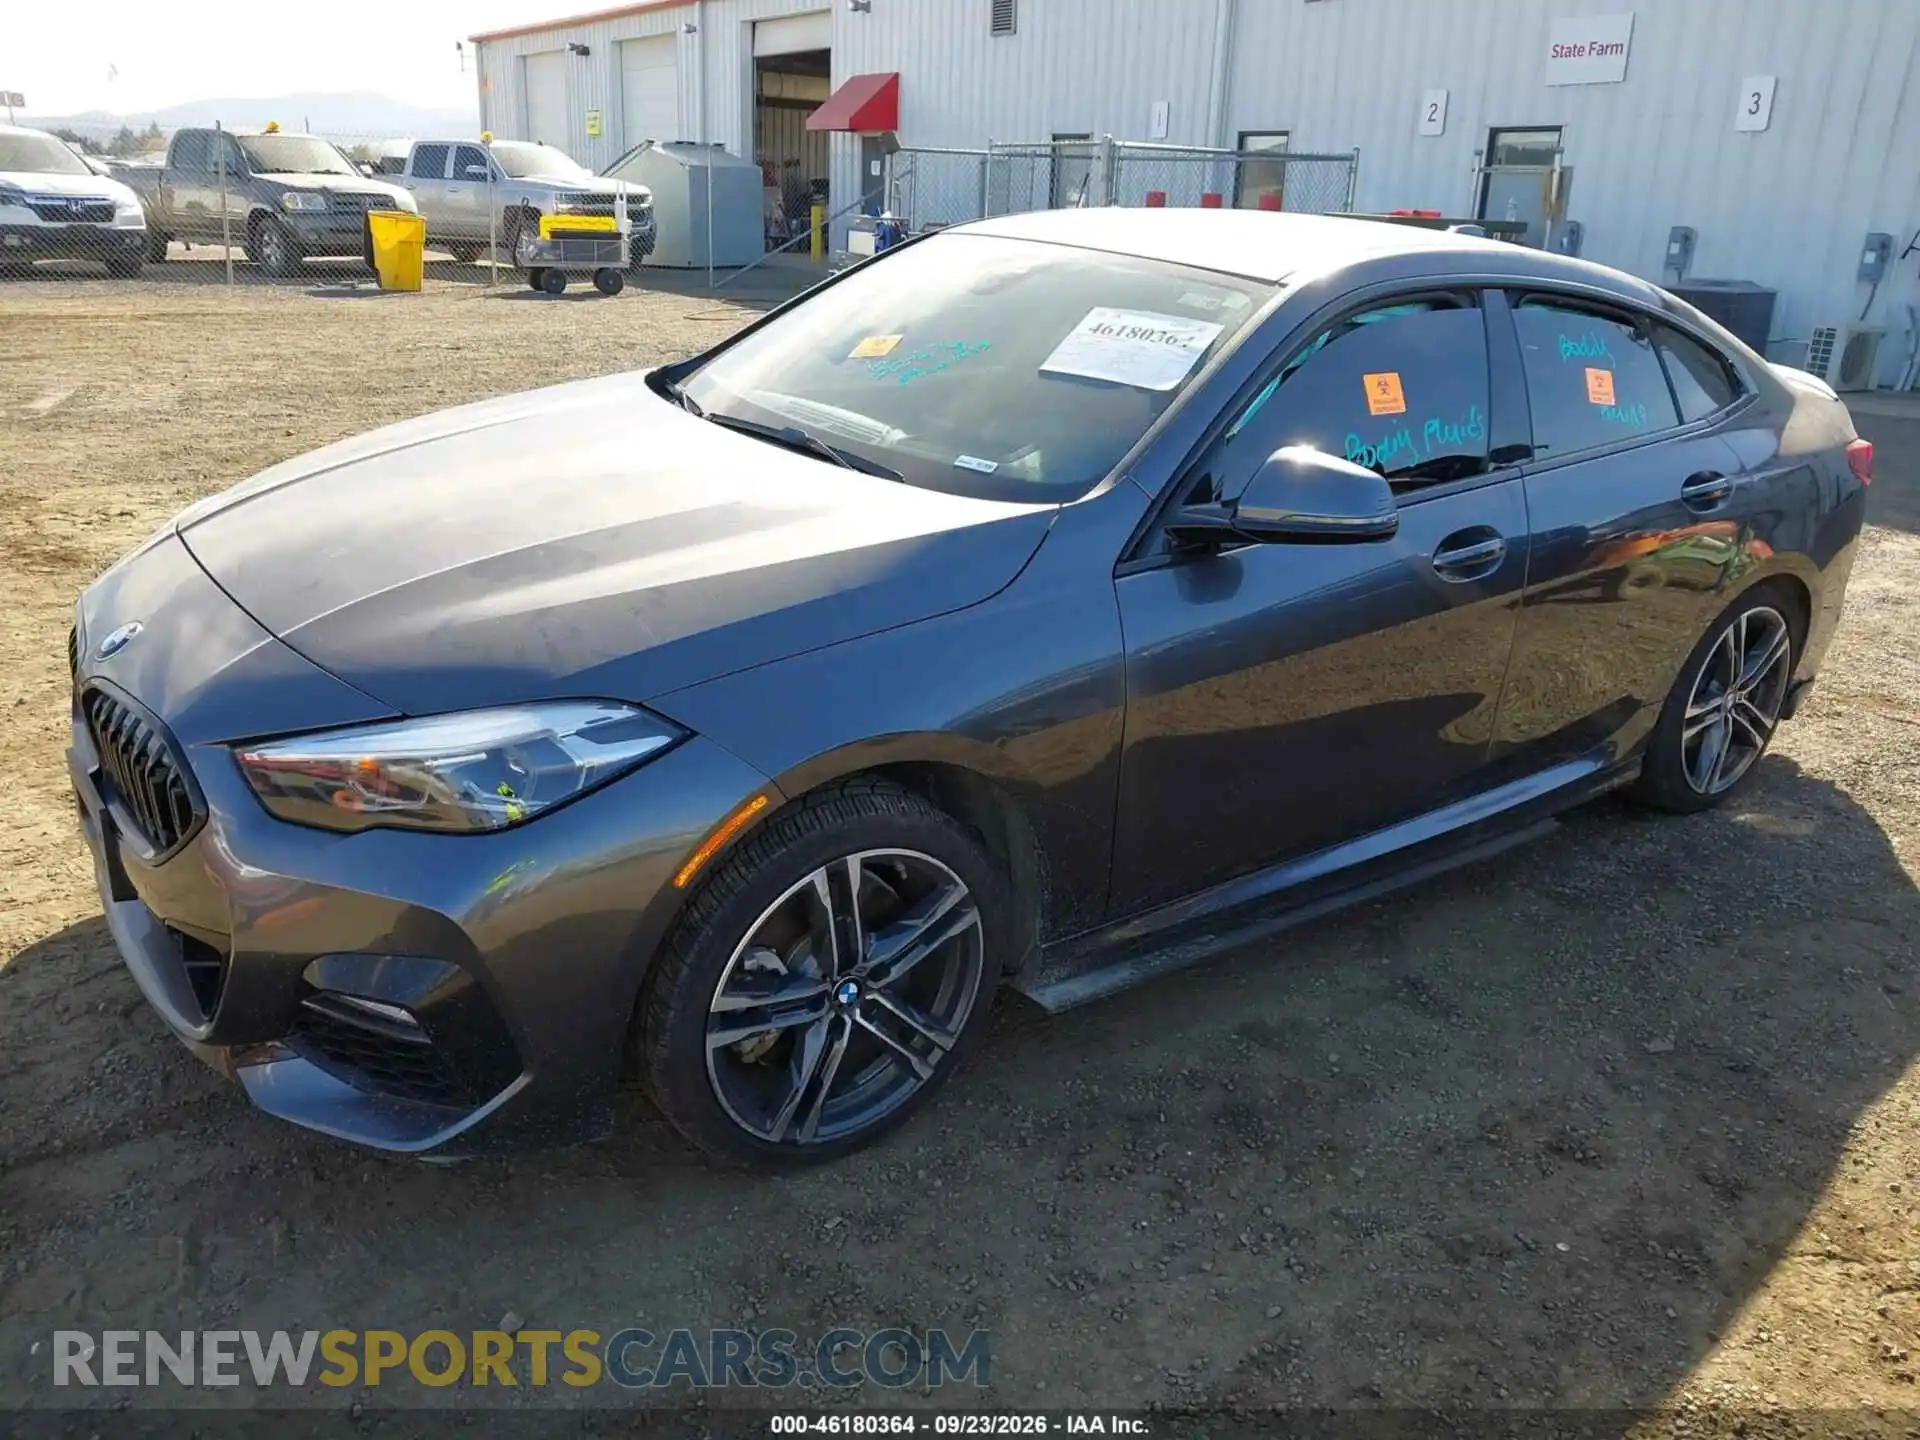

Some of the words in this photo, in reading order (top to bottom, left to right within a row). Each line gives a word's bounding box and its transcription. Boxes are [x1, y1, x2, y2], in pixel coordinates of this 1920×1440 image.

[1551, 43, 1585, 58] State
[1588, 41, 1624, 56] Farm
[1427, 103, 1438, 122] 2
[1748, 92, 1761, 115] 3
